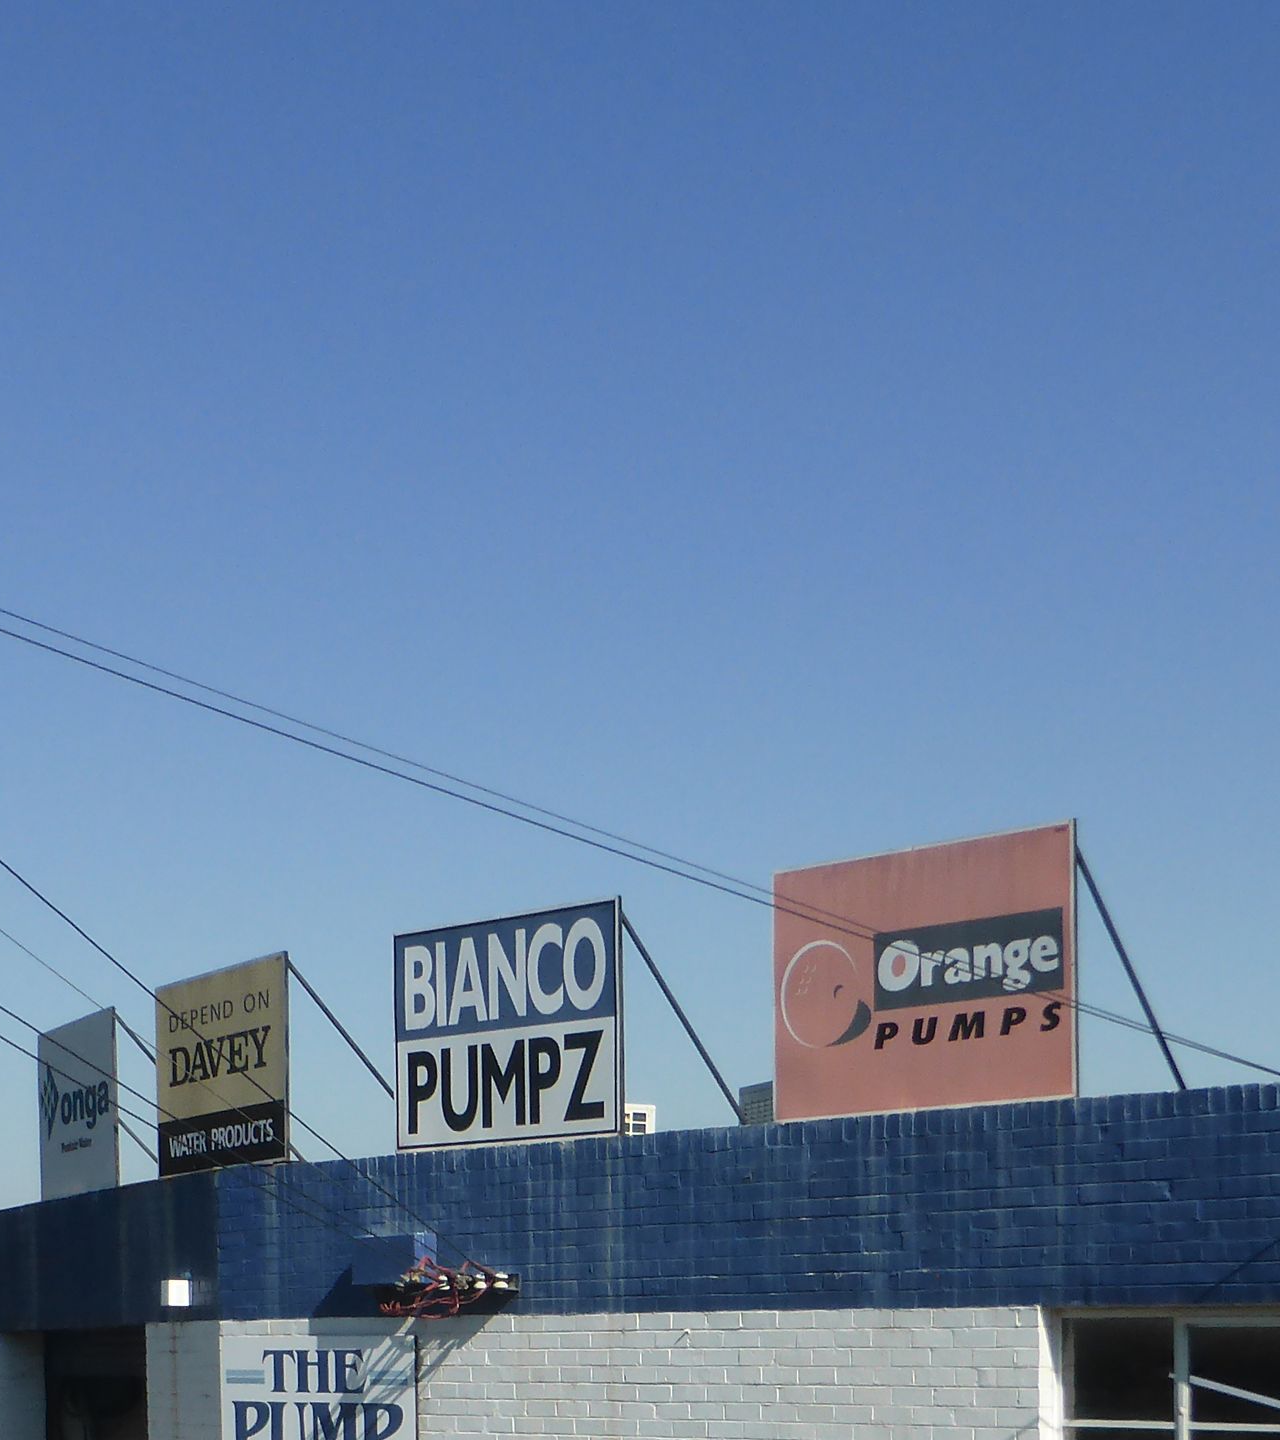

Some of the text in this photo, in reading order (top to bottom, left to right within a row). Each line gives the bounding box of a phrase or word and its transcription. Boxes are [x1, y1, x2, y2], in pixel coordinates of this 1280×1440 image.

[404, 917, 606, 1031] BIANCO
[877, 934, 1059, 991] Orange
[169, 989, 269, 1033] DEPEND ON
[874, 1001, 1062, 1049] PUMPS
[168, 1025, 271, 1087] DAVEY
[61, 1081, 109, 1130] onga
[408, 1029, 605, 1134] PUMPZ
[169, 1118, 273, 1158] WATER PRODUCTS
[262, 1349, 367, 1394] THE
